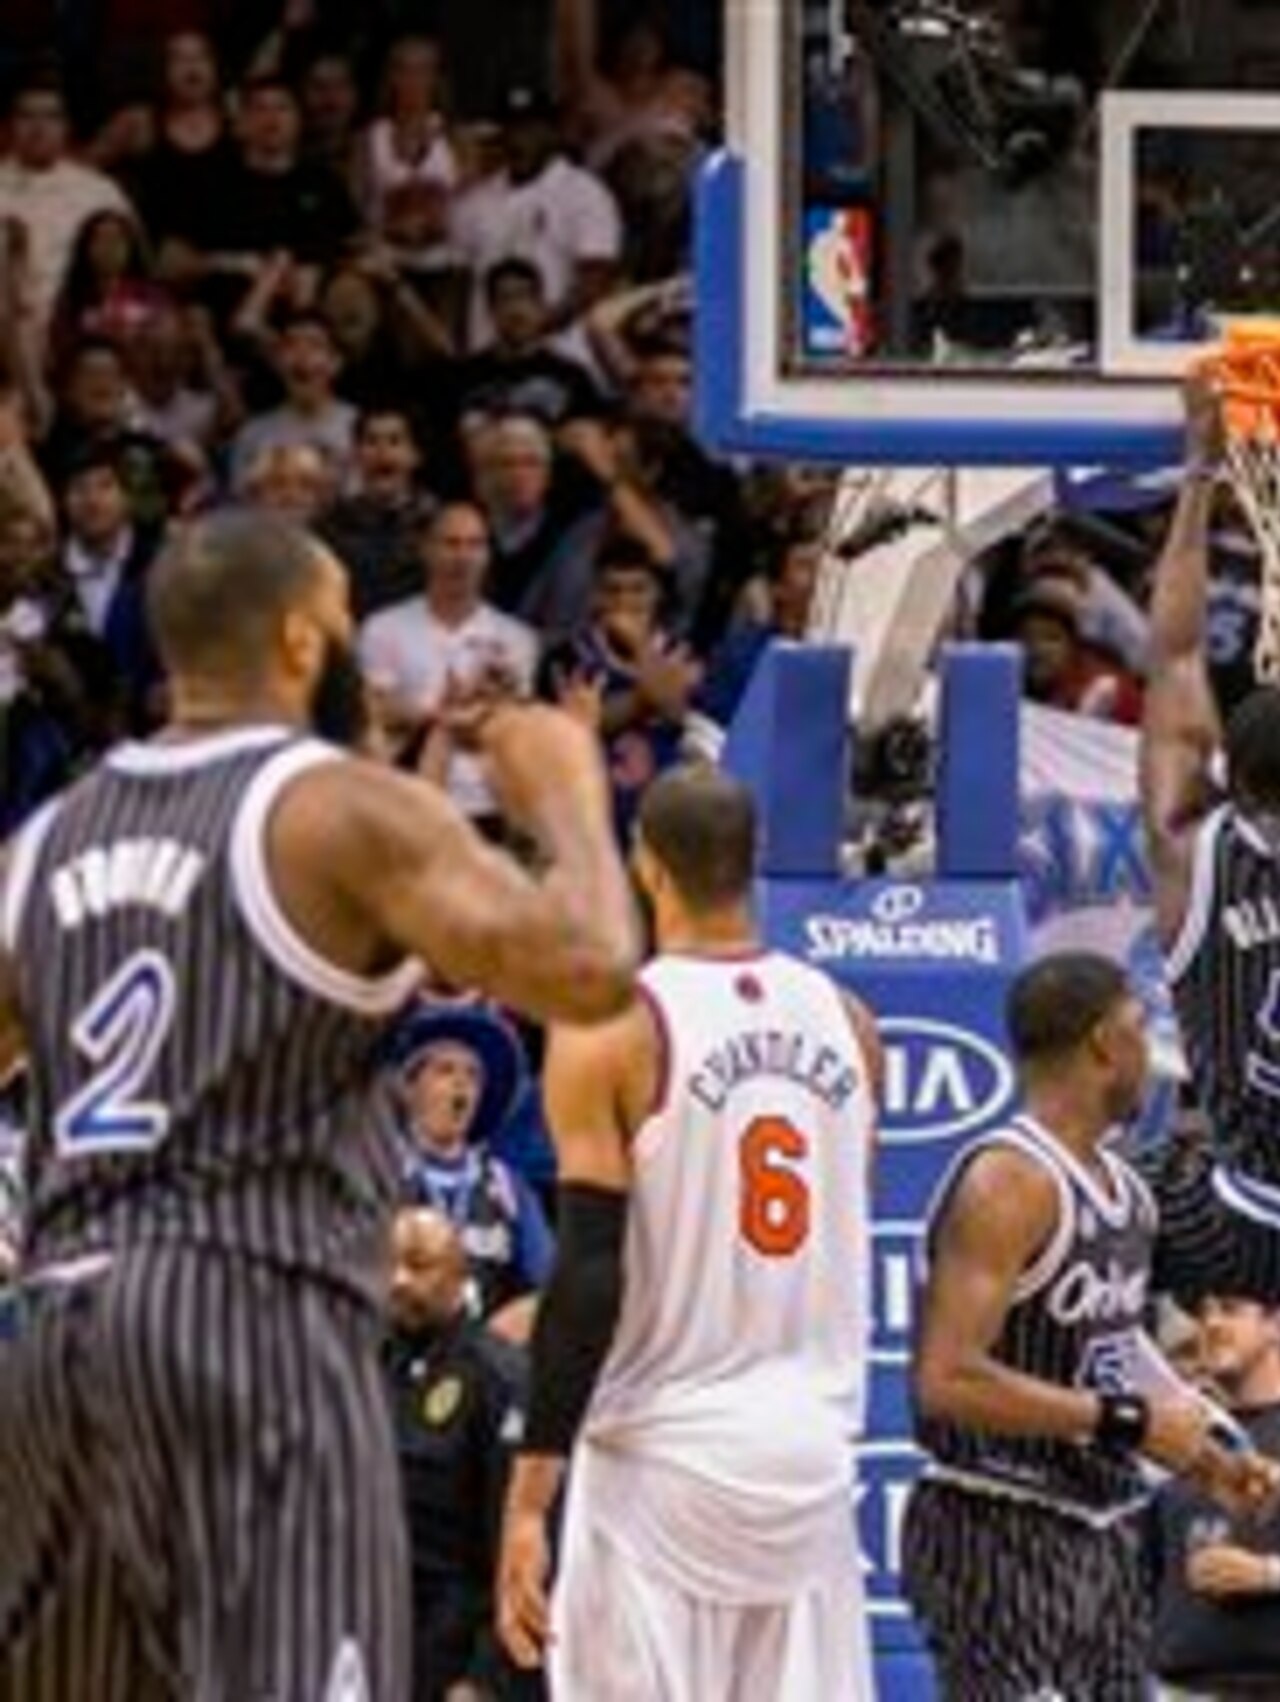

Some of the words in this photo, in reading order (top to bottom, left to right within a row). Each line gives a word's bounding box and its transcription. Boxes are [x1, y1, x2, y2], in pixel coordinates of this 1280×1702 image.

[805, 913, 999, 963] SPALDING
[55, 948, 175, 1156] 2
[884, 1046, 973, 1113] IA
[739, 1115, 810, 1256] 6
